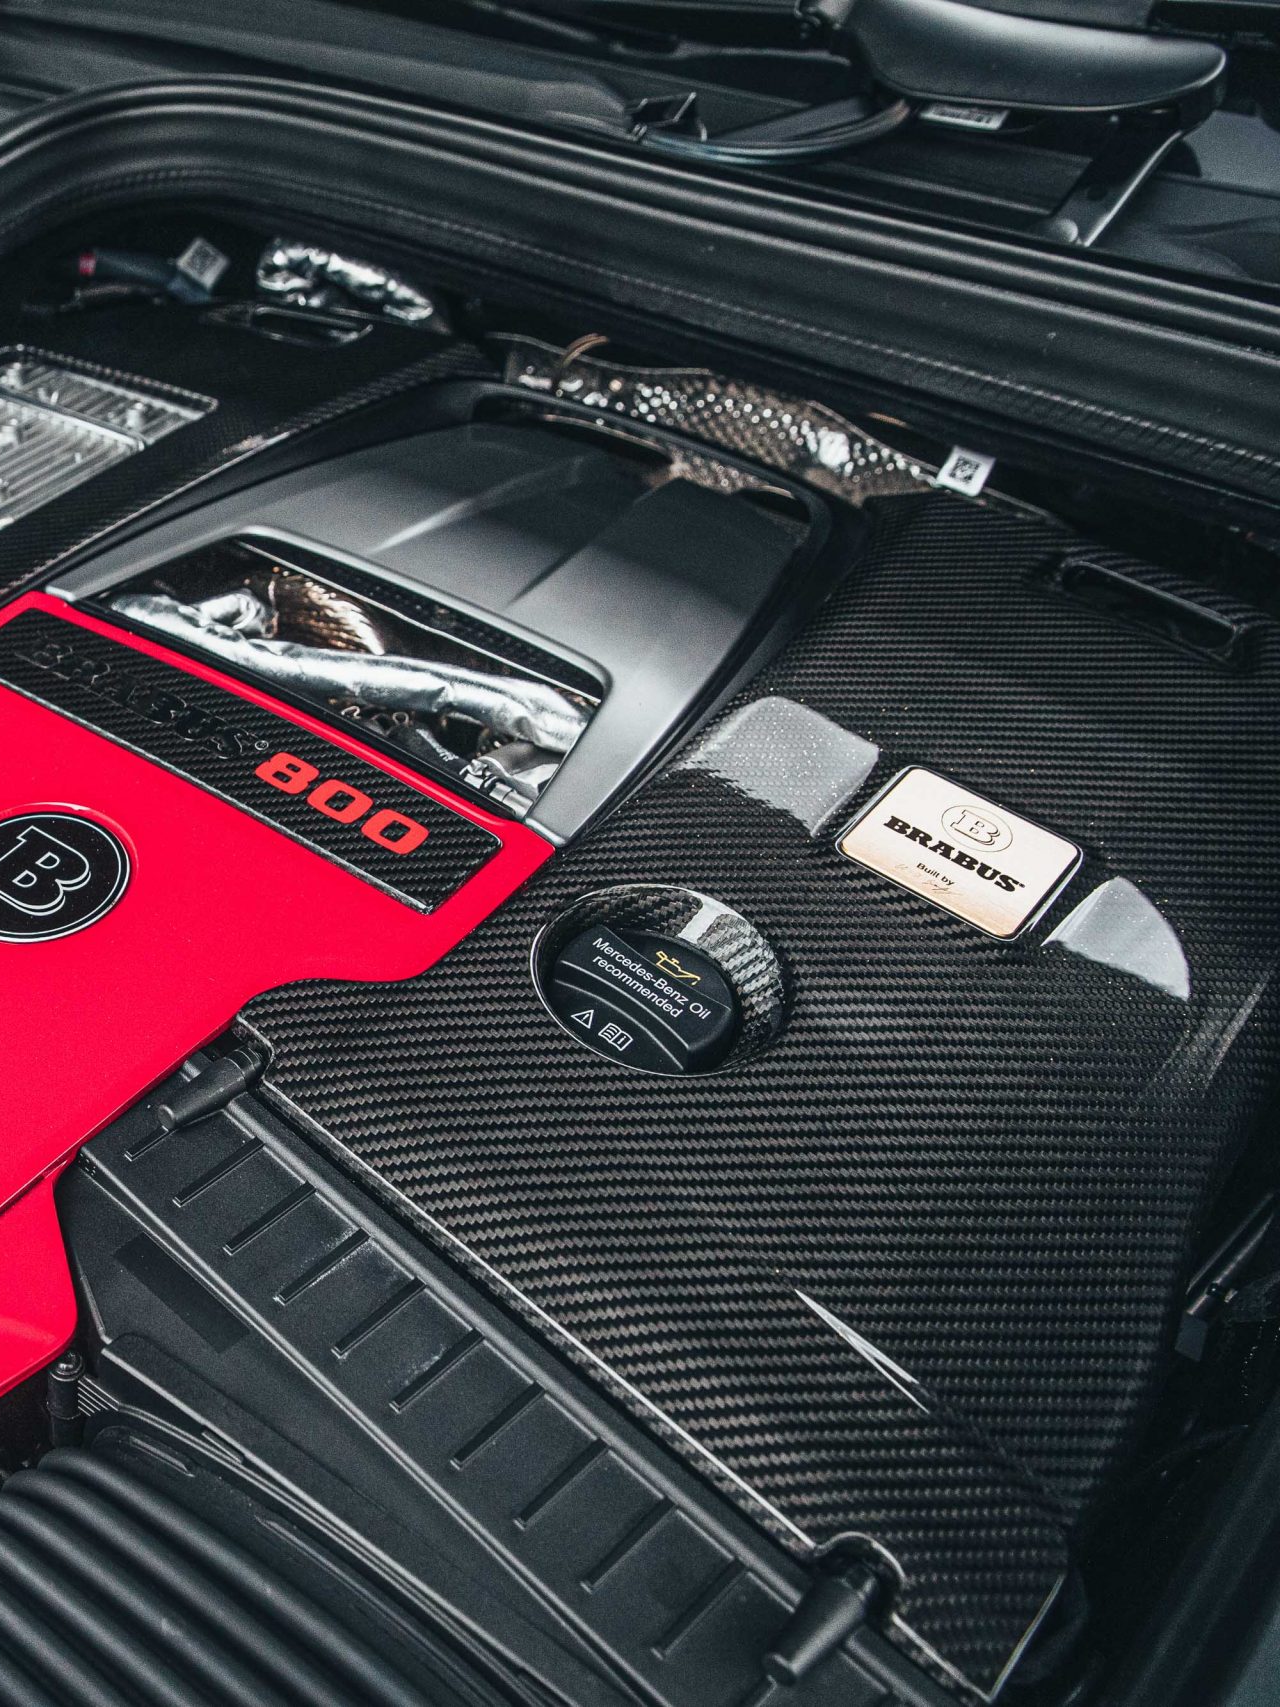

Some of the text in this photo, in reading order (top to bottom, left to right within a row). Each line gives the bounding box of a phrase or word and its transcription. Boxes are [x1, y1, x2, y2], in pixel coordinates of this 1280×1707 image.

[254, 752, 429, 856] 800
[916, 862, 940, 879] Built
[941, 875, 955, 886] by
[592, 936, 711, 1020] Mercedes-Benz Oil
[592, 954, 684, 1018] recommended
